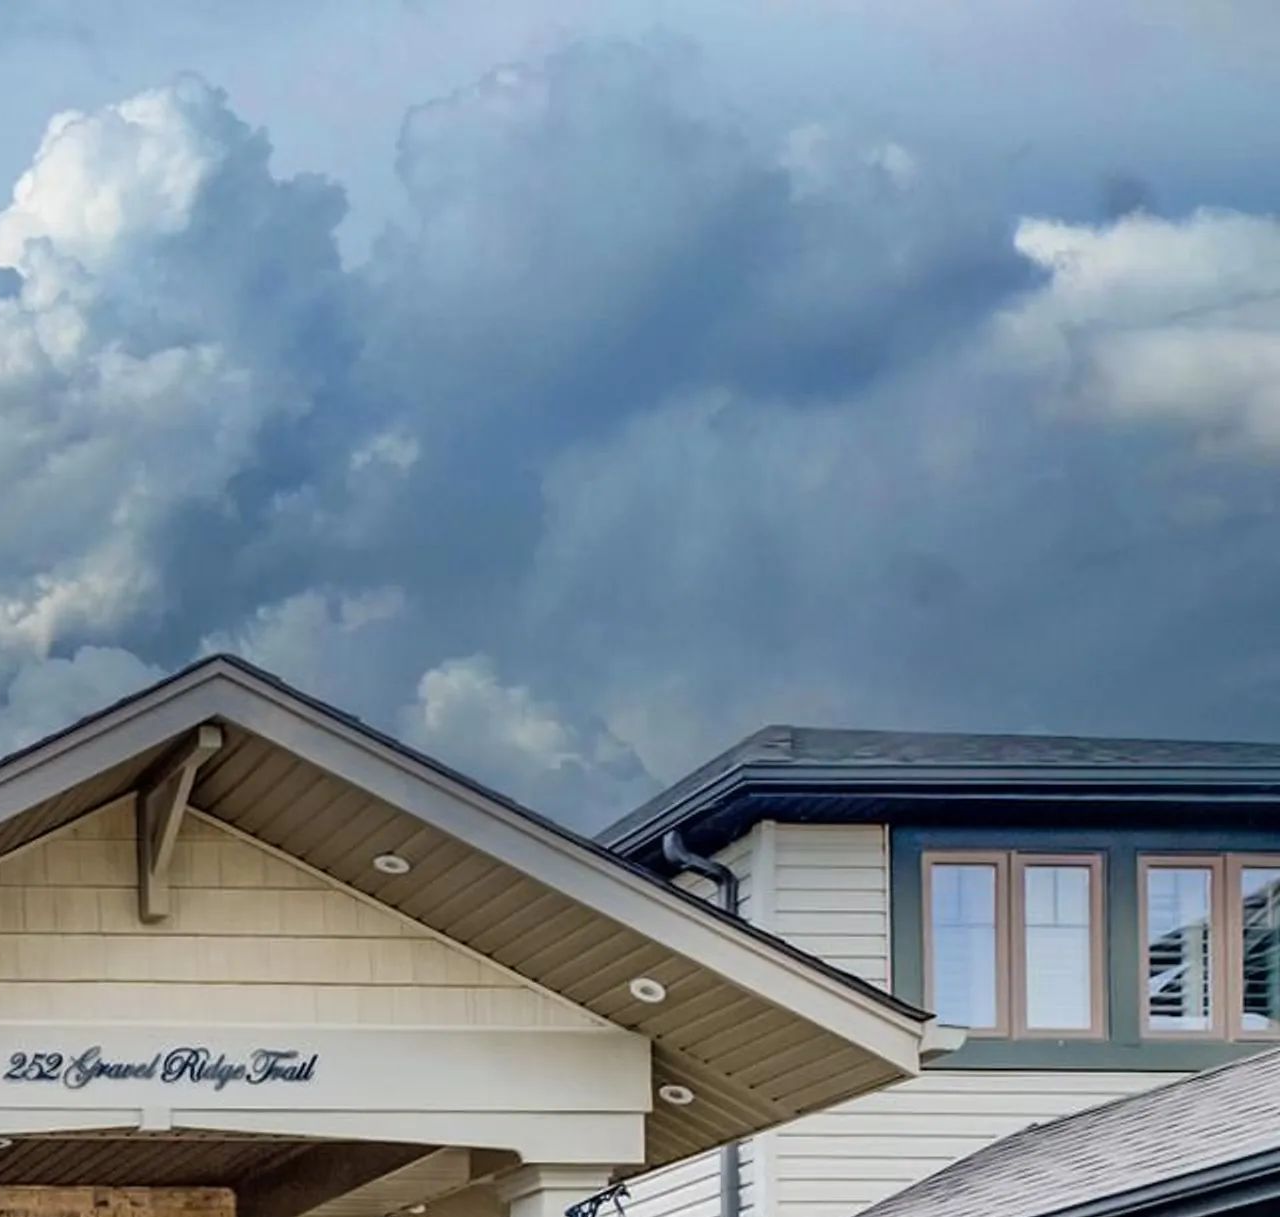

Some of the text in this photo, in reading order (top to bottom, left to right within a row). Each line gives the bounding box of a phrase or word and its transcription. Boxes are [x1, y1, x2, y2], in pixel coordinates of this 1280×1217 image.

[3, 1046, 318, 1091] 252 Gravel Ridge Trail
